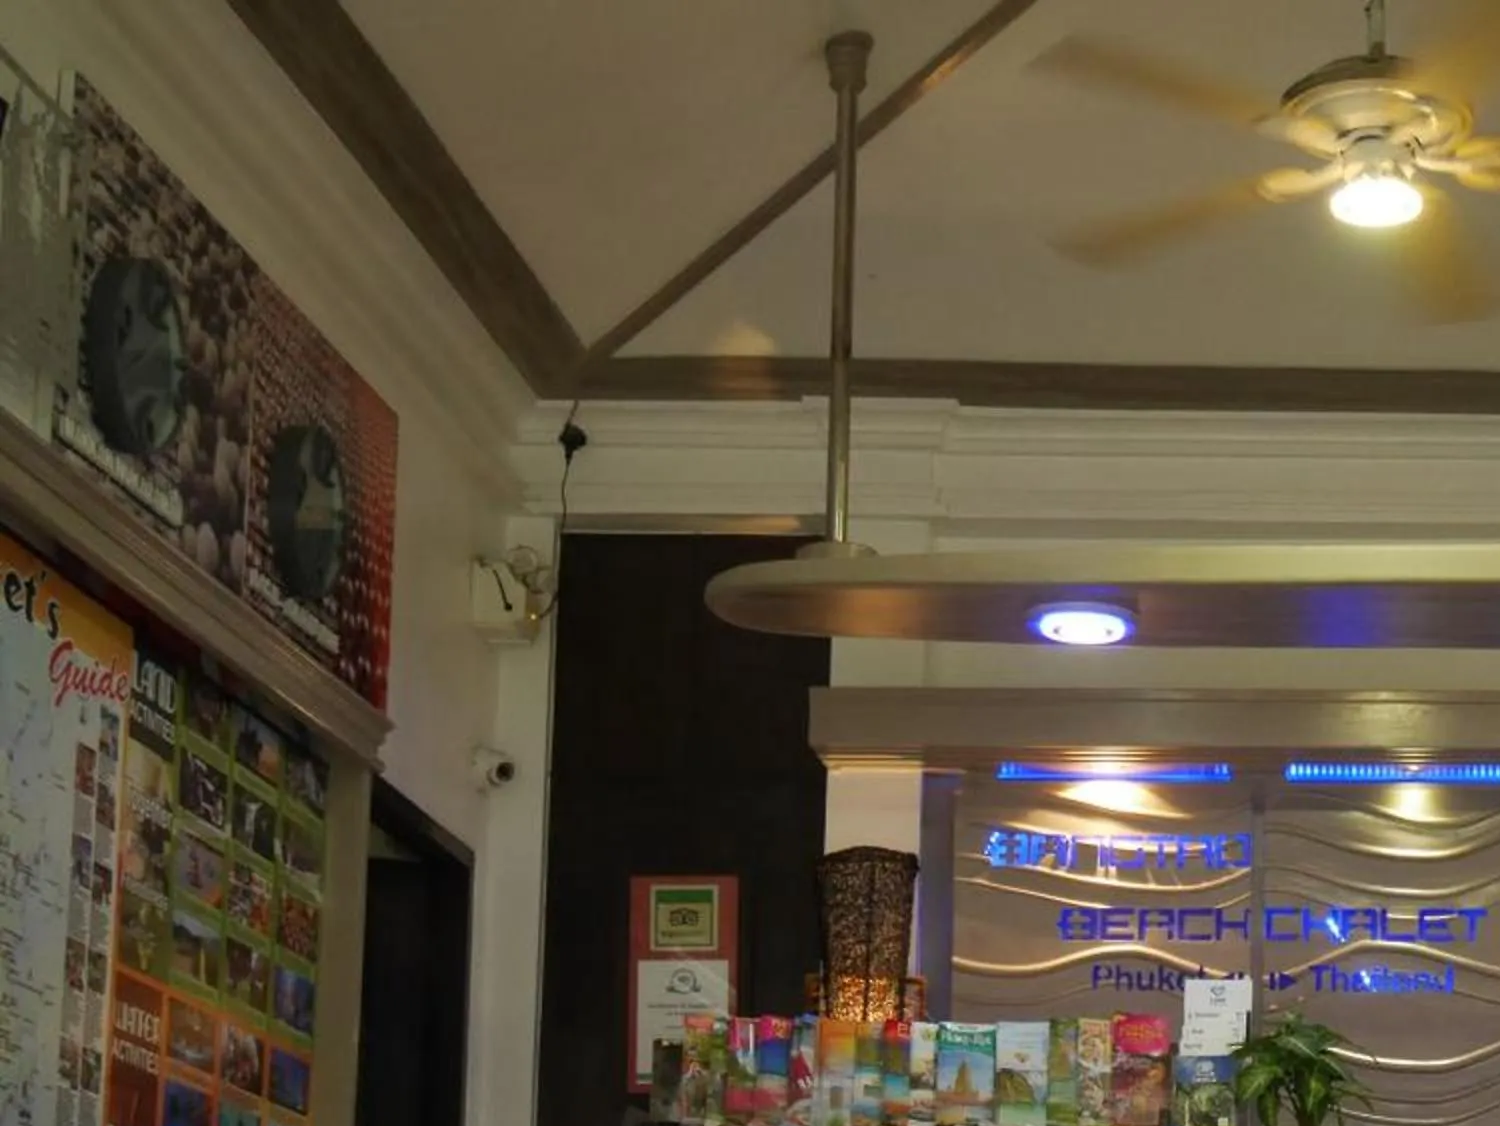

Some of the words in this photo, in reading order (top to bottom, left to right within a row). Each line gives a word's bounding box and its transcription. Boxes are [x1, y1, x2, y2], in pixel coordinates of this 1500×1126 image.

[4, 572, 59, 640] et's
[49, 640, 129, 708] Guide
[132, 649, 176, 715] LAND
[1056, 907, 1252, 942] BEACH
[1263, 906, 1489, 943] CHALET
[1309, 961, 1455, 995] Thailand
